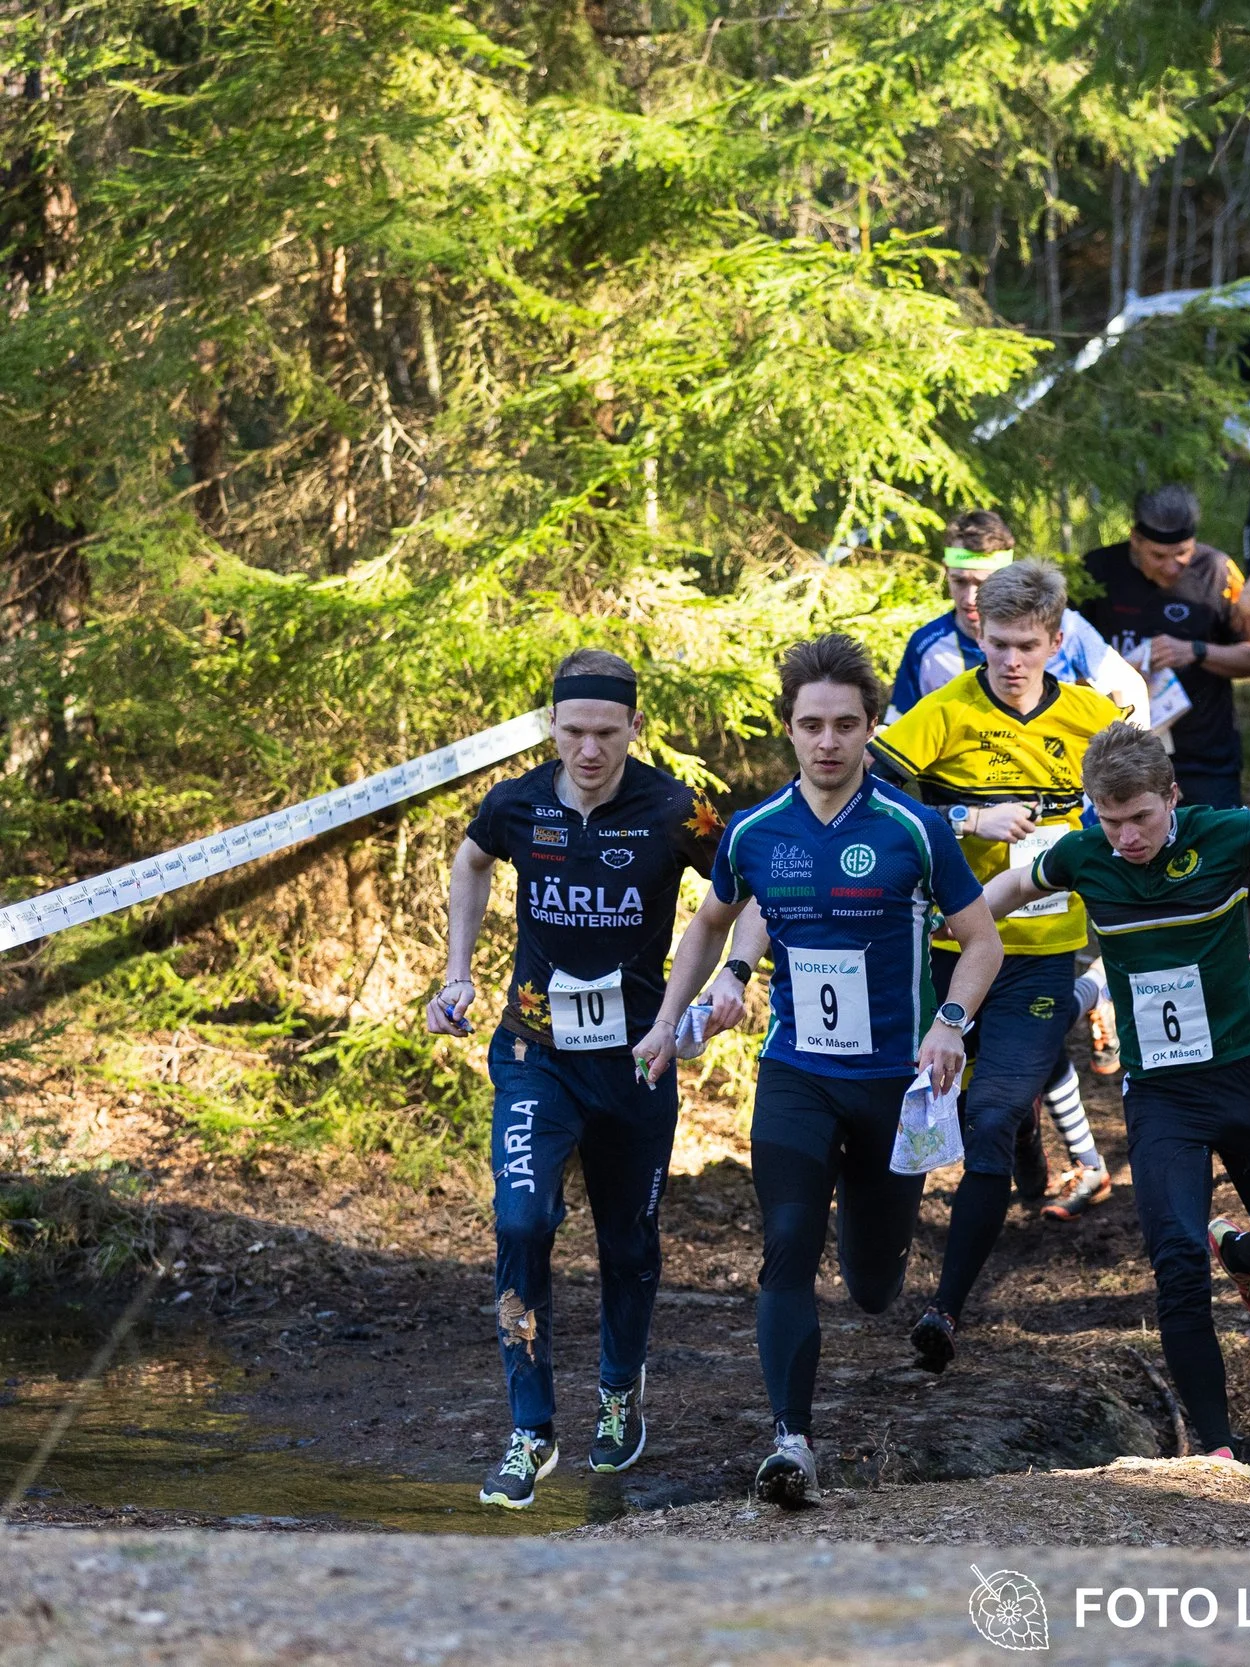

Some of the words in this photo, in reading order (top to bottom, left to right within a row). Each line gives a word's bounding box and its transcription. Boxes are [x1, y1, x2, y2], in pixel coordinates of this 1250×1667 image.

[831, 792, 863, 829] noname
[598, 829, 650, 837] LUMONITE
[531, 851, 567, 862] mercur
[771, 860, 814, 869] HELSINKI
[771, 869, 812, 879] O-Games
[529, 876, 644, 914] JÄRLA
[530, 906, 643, 928] ORIENTERING
[832, 908, 884, 917] noname
[795, 961, 838, 974] NOREX
[1136, 982, 1176, 995] NOREX
[569, 991, 604, 1028] 10
[820, 983, 838, 1031] 9
[1162, 1000, 1181, 1043] 6
[565, 1035, 581, 1045] OK
[583, 1033, 616, 1044] Måsen
[807, 1036, 824, 1047] OK
[826, 1038, 859, 1049] Måsen
[1152, 1051, 1167, 1061] OK
[1170, 1048, 1201, 1059] Måsen
[504, 1100, 539, 1193] JÄRLA
[646, 1166, 663, 1217] TRIMTEX
